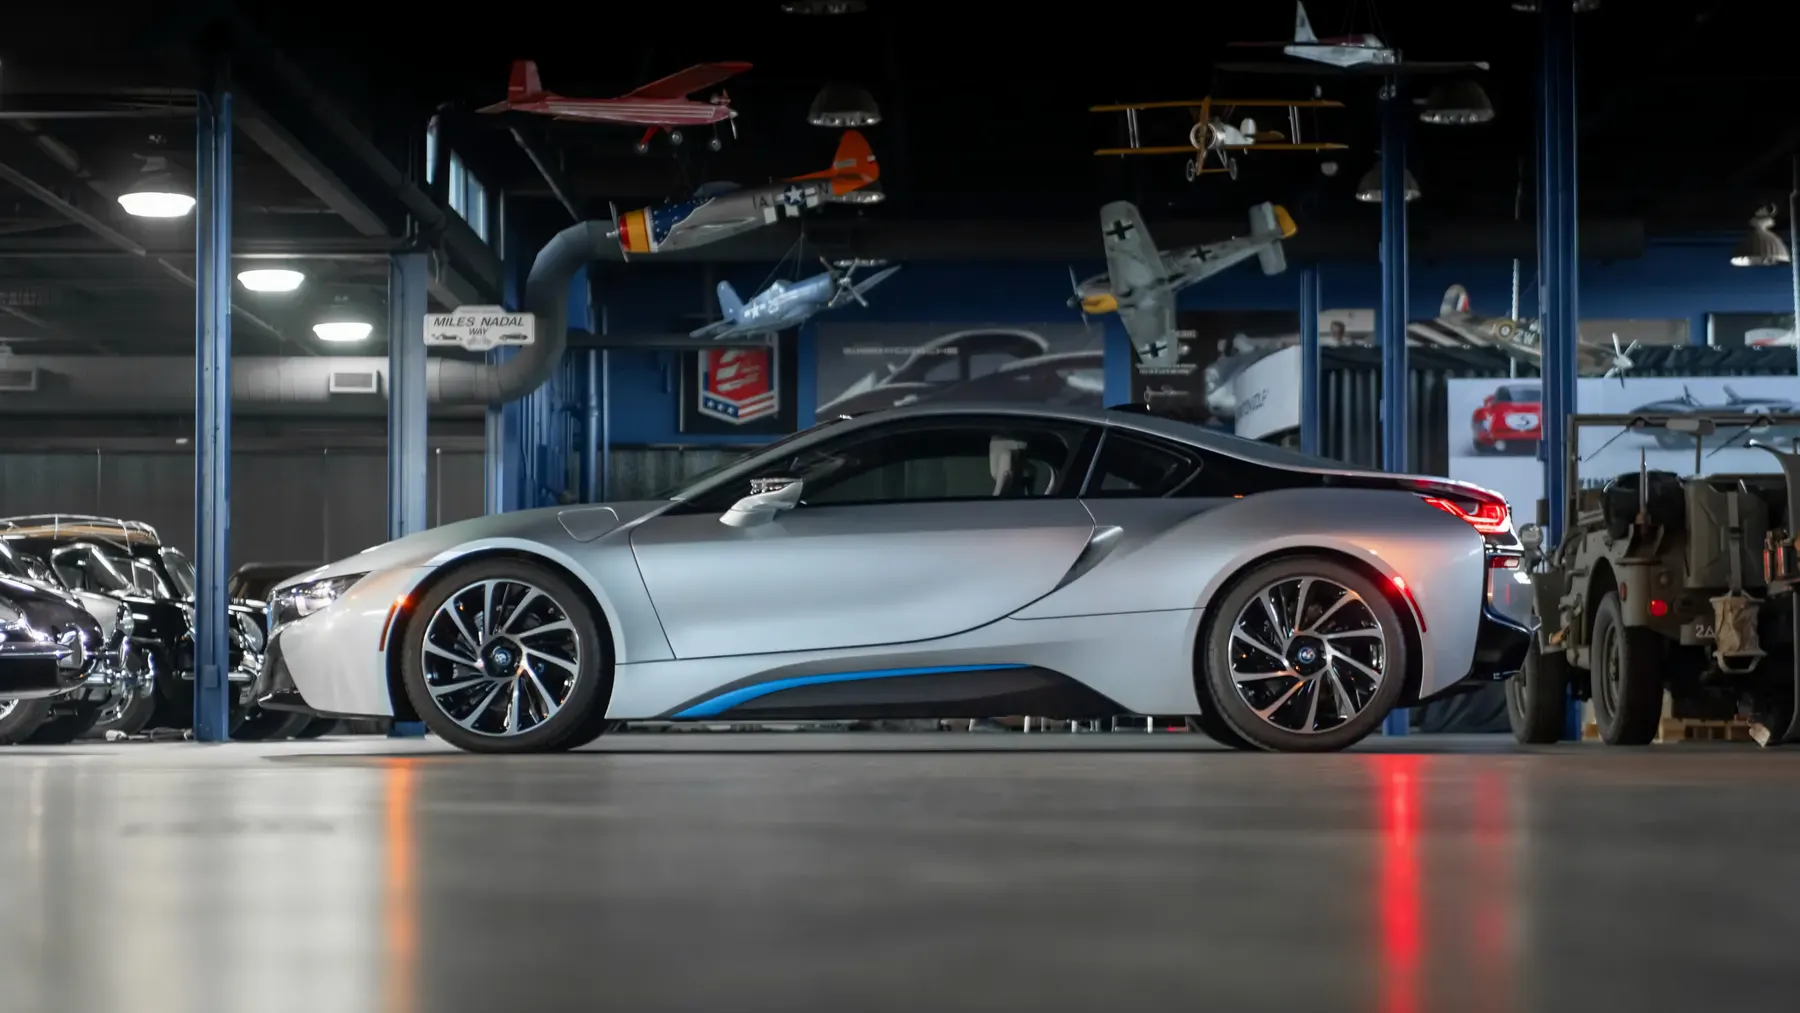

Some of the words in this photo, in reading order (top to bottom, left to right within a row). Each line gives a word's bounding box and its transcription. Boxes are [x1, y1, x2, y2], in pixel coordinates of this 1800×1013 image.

[433, 317, 475, 327] MILES
[480, 317, 524, 327] NADAL
[469, 328, 488, 336] WAY
